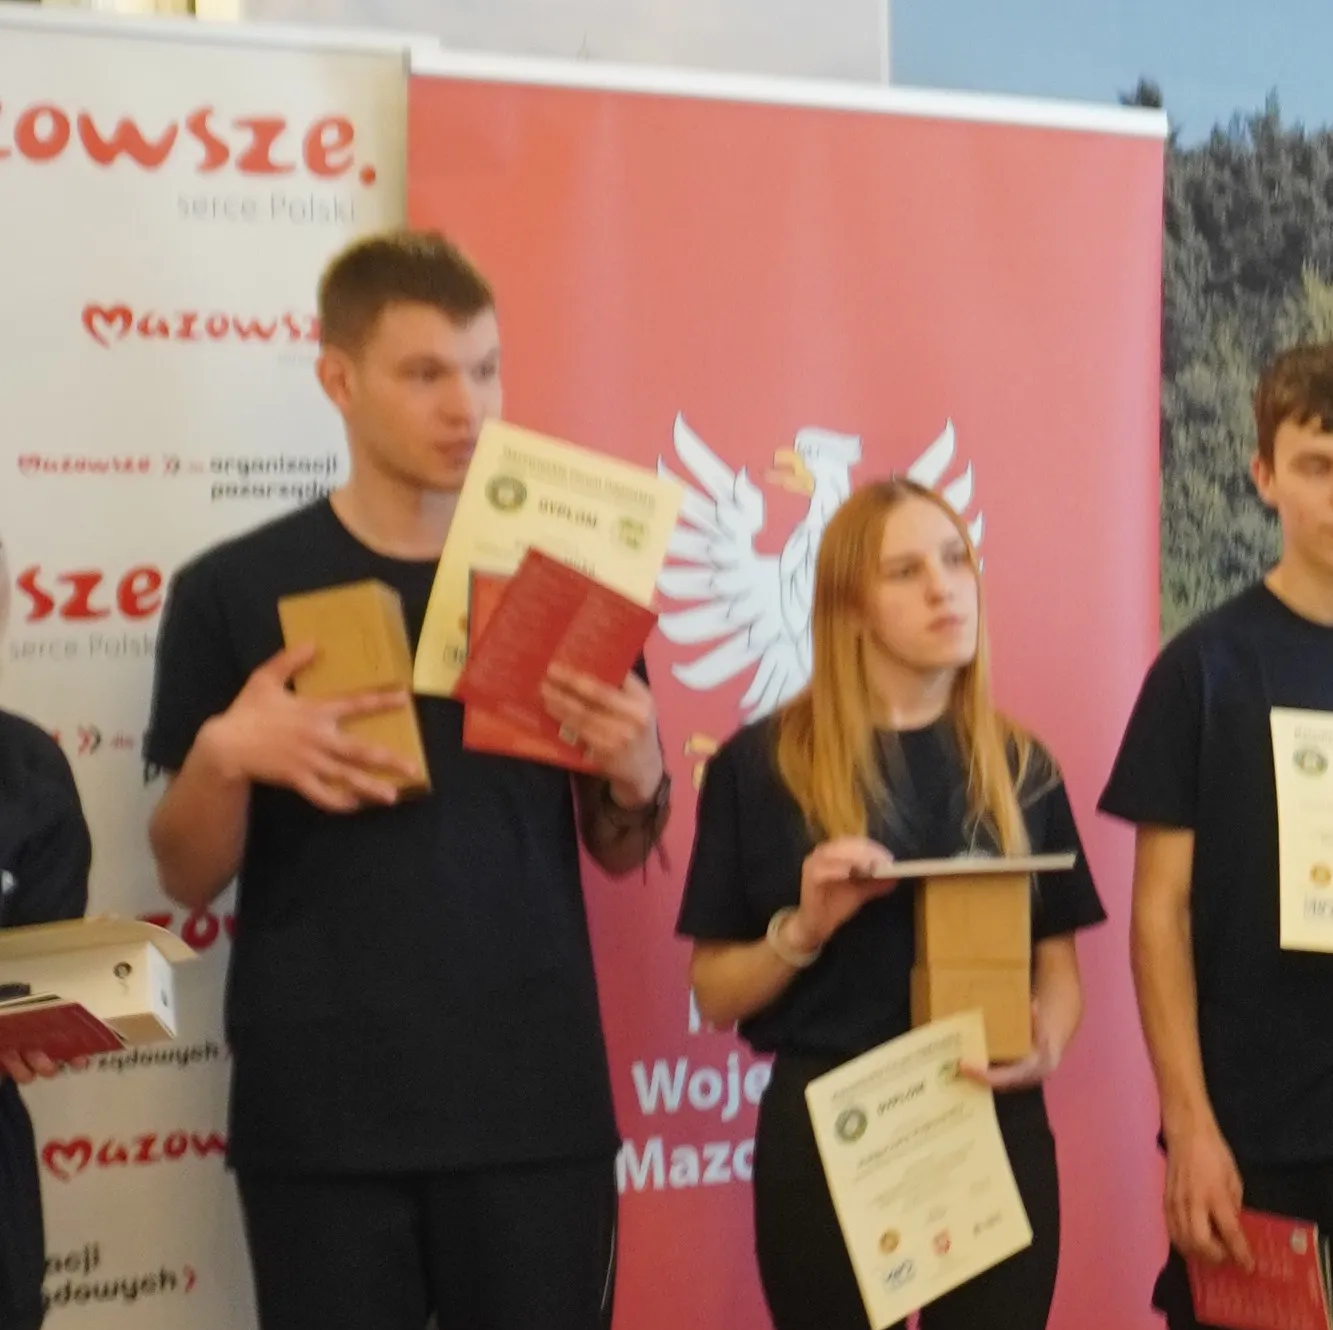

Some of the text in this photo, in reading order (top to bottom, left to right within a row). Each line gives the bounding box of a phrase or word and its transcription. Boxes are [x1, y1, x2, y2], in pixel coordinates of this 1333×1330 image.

[0, 104, 376, 186] owsze.
[271, 194, 355, 224] Polski
[82, 302, 320, 347] Mazowsz
[16, 564, 162, 623] sze
[88, 633, 154, 659] Polsk
[630, 1049, 774, 1123] Woje
[42, 1131, 229, 1182] Mazow
[615, 1134, 755, 1195] Mazo
[43, 1266, 177, 1310] dowych
